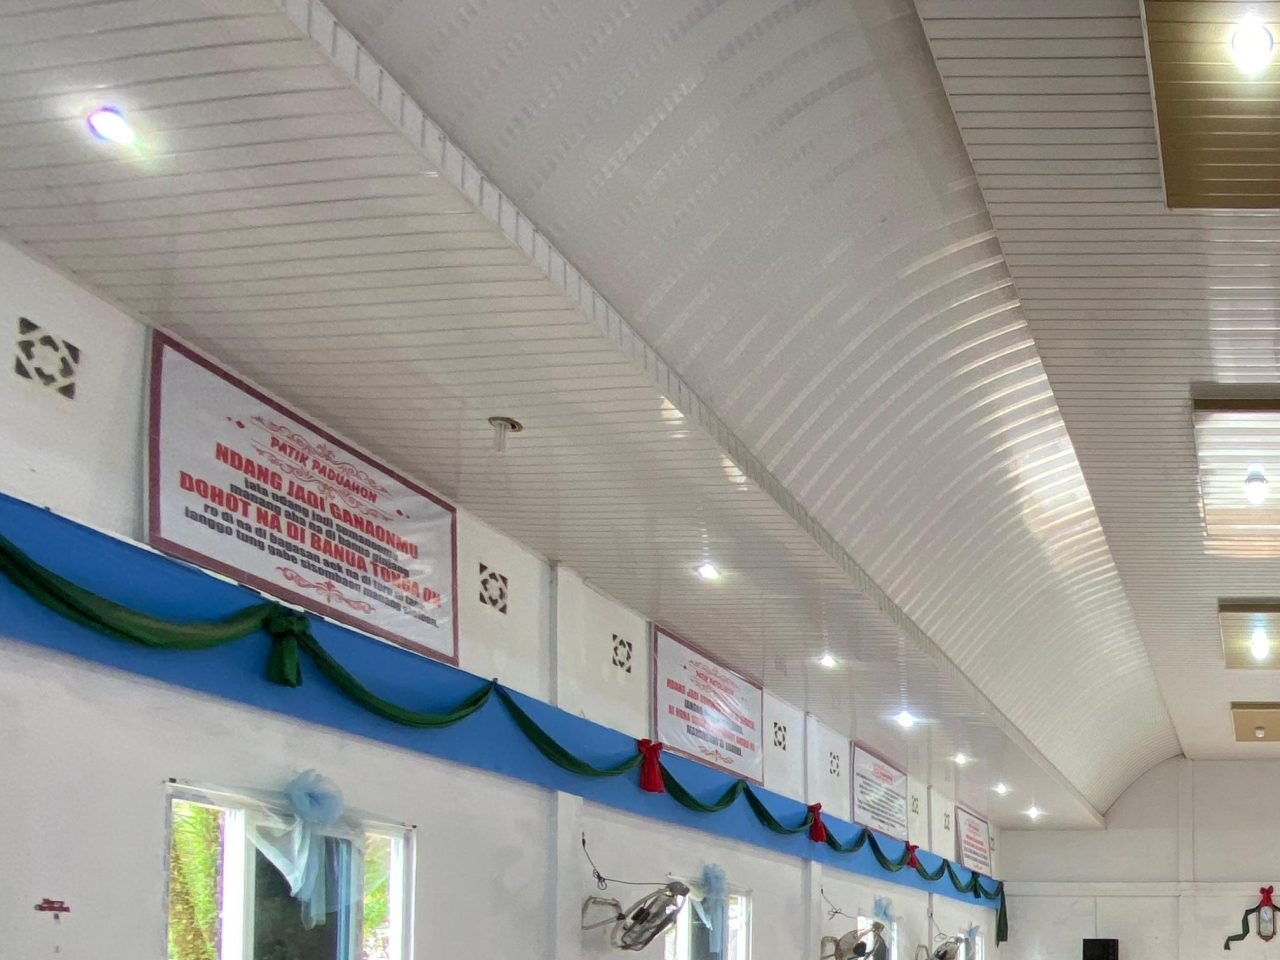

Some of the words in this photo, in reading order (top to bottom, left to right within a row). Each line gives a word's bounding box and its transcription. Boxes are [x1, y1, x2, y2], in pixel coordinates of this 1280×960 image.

[215, 441, 282, 492] NDANG
[286, 478, 325, 514] JADI
[270, 435, 308, 467] PATIK
[311, 457, 377, 505] PADUAHON
[179, 468, 251, 520] DOHOT
[256, 505, 282, 534] NA
[286, 520, 305, 545] DI
[310, 531, 368, 574] BANUA
